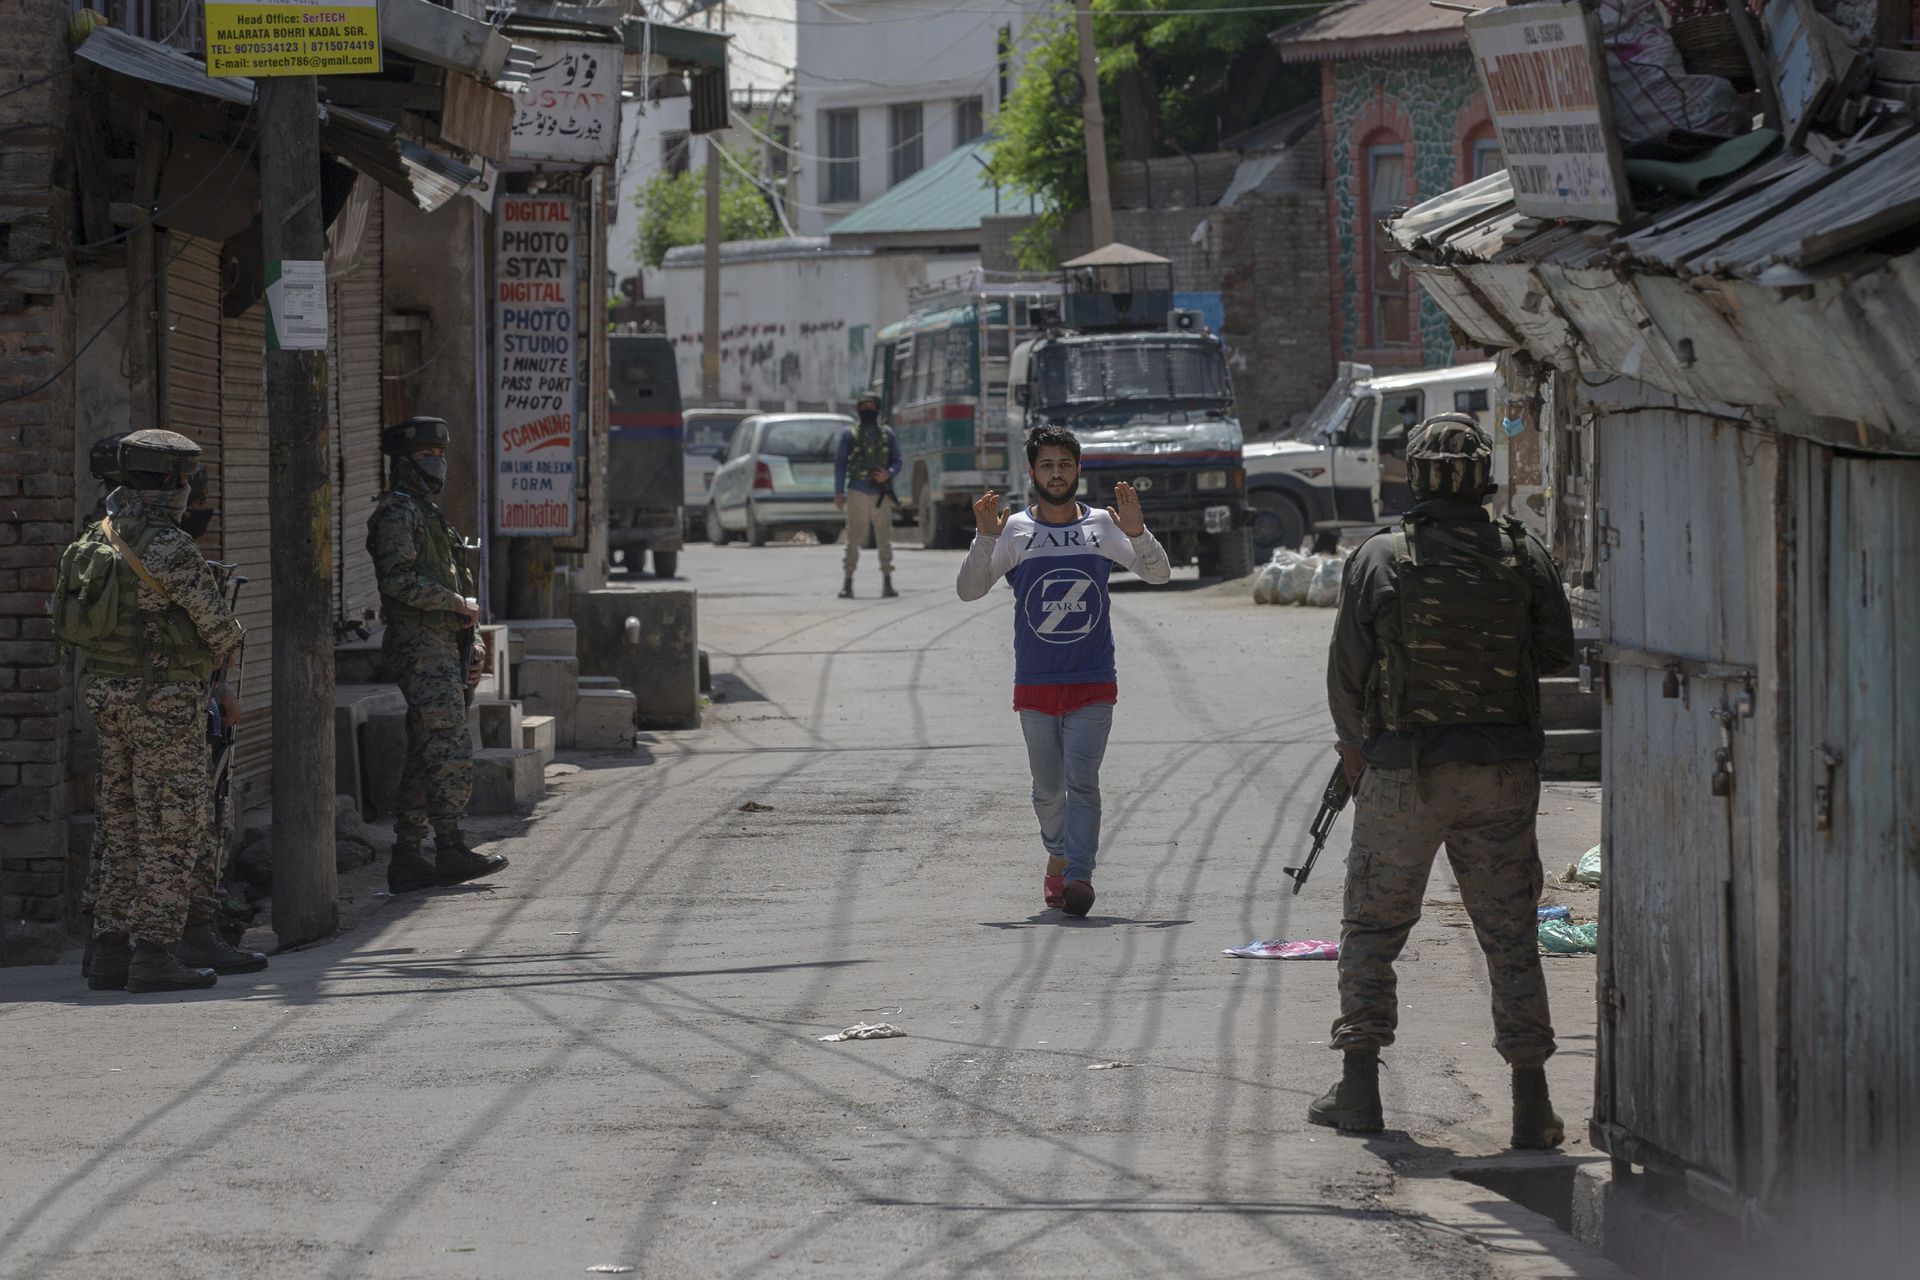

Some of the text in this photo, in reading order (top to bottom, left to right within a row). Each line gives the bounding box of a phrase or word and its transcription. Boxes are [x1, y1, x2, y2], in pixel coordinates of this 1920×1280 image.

[237, 12, 345, 25] Head Office: SerTECH
[217, 26, 368, 40] MALARATA BOHRI KADAL SGR.
[211, 44, 232, 55] TEL:
[235, 42, 299, 54] 9070534123
[311, 40, 375, 52] 8715074419
[215, 55, 373, 69] E-mail: sertech786@gmail.com
[504, 201, 571, 222] DIGITAL
[502, 231, 569, 253] PHOTO
[505, 257, 567, 279] STAT
[500, 281, 565, 302] DIGITAL
[503, 309, 571, 332] PHOTO
[504, 334, 569, 354] STUDIO
[503, 356, 509, 371] 1
[513, 356, 568, 373] MINUTE
[501, 375, 573, 392] PASS PORT
[504, 394, 563, 410] PHOTO
[501, 413, 571, 452] SCANNING
[512, 477, 553, 491] FORM
[500, 499, 569, 529] Lamination
[1024, 530, 1101, 551] ZARA
[1044, 601, 1084, 611] ZARA
